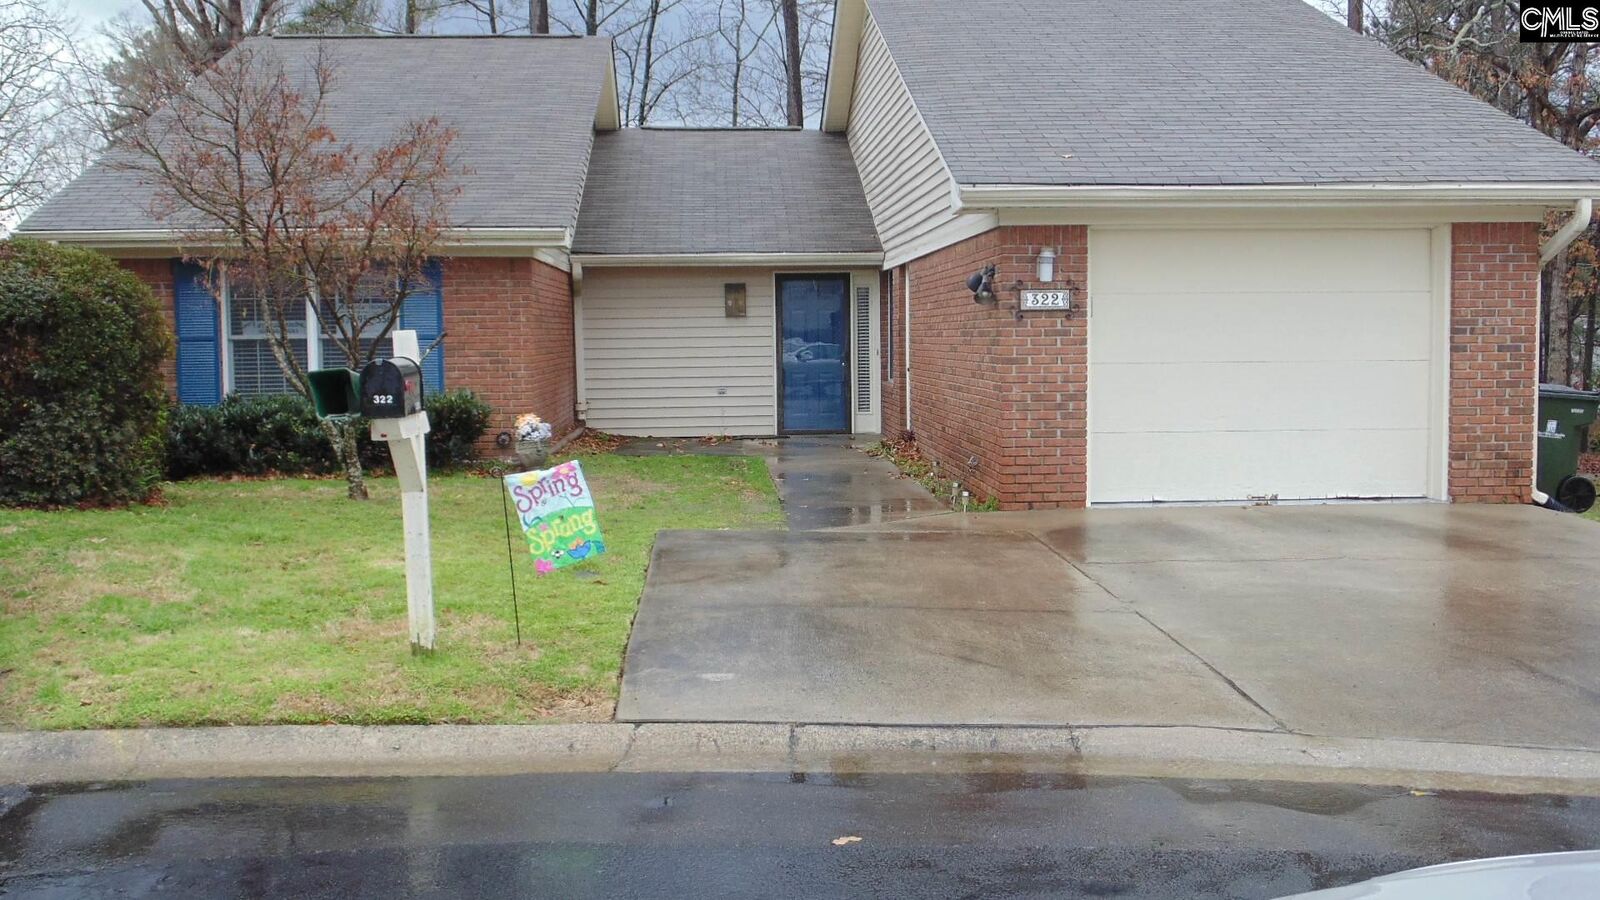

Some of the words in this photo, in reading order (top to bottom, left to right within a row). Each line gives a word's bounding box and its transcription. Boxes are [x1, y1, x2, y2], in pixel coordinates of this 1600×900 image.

[1031, 293, 1060, 306] 322
[373, 395, 393, 404] 322
[513, 473, 583, 512] Spring
